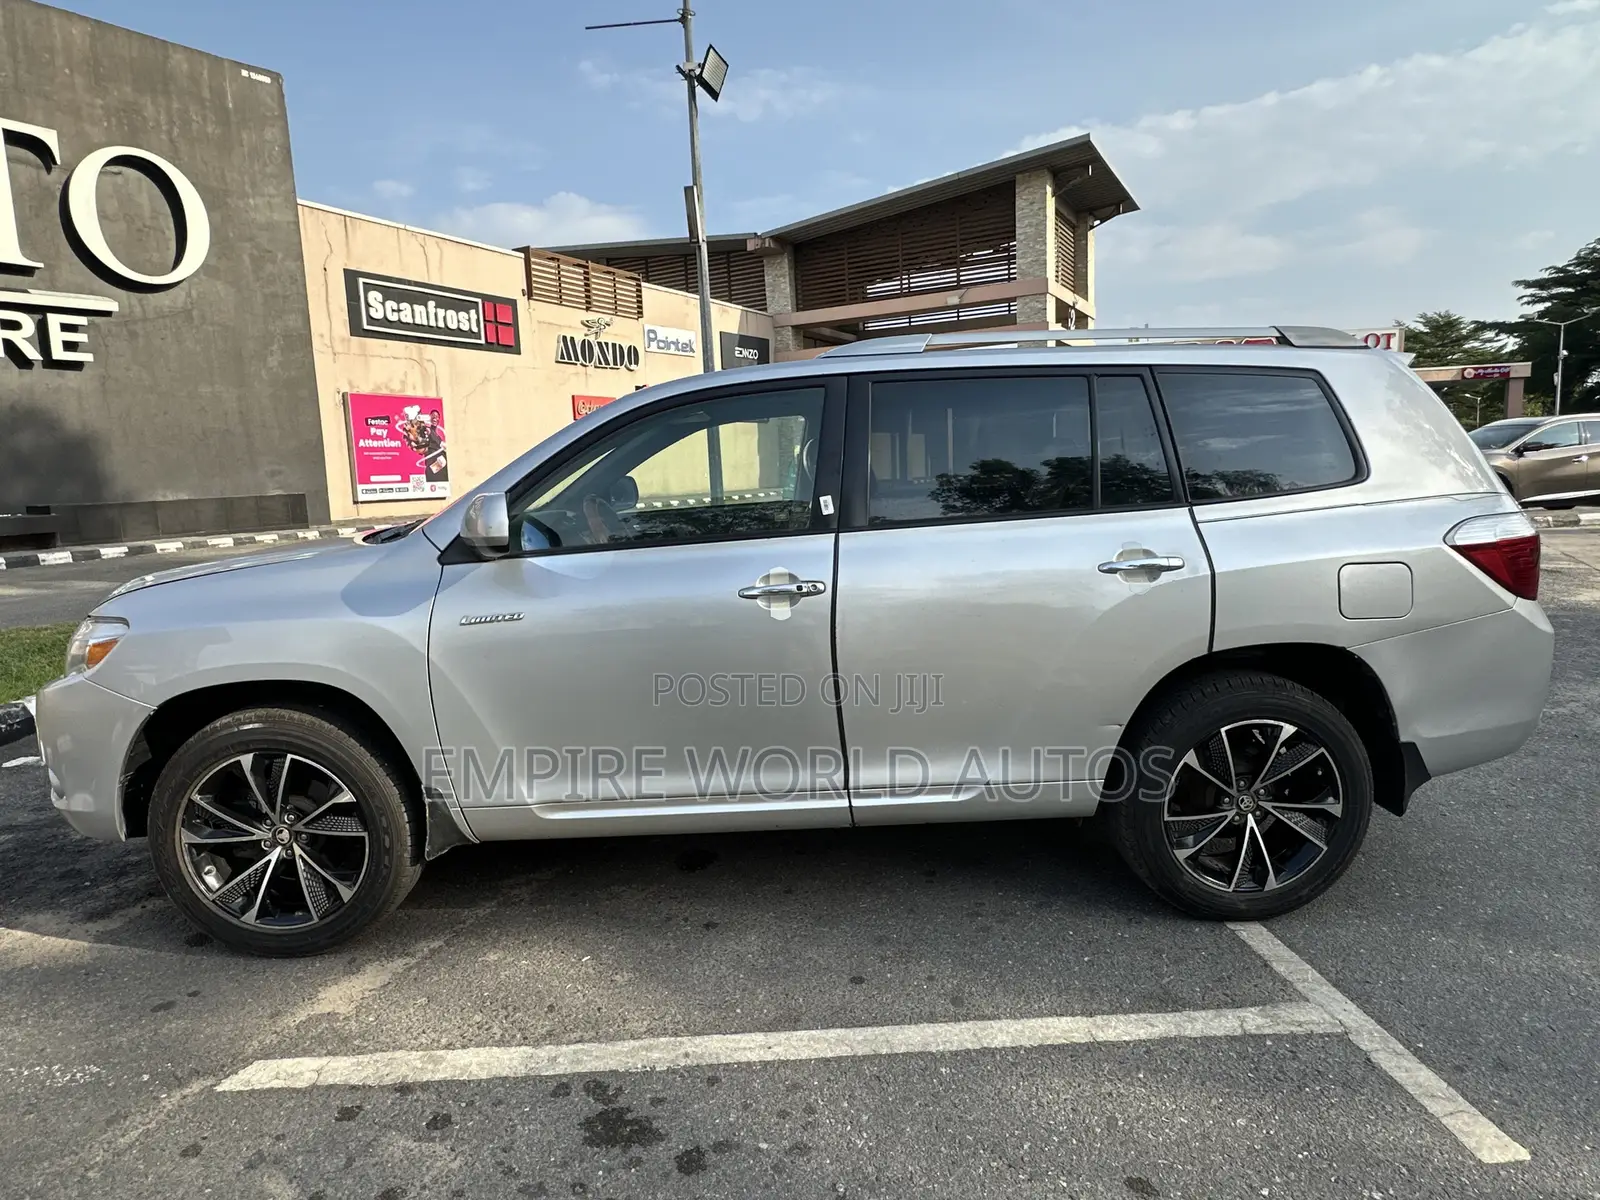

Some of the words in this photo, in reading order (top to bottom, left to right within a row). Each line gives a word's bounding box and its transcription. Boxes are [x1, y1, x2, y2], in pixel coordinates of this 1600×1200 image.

[367, 290, 479, 333] Scanfrost
[556, 334, 640, 370] MONDO
[646, 328, 695, 354] Pointek
[358, 438, 402, 448] Attention
[370, 427, 388, 438] Pay
